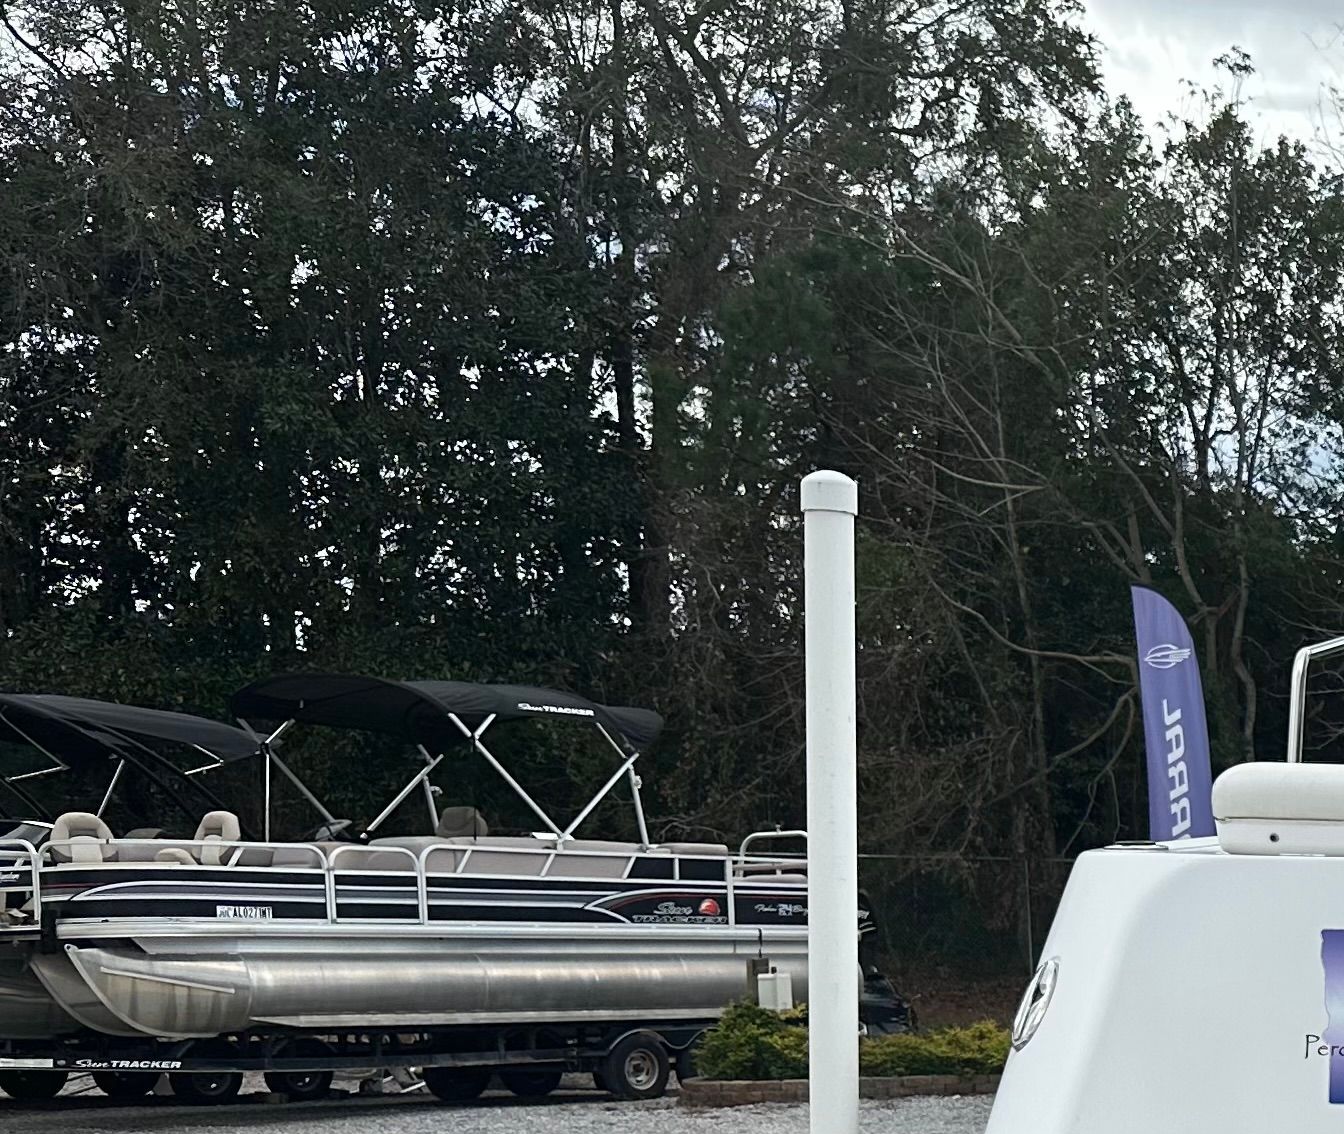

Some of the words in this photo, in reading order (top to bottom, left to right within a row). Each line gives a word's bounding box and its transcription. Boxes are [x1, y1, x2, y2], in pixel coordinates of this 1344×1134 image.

[542, 705, 595, 717] TRACKER
[632, 914, 729, 924] TRACKER
[110, 1060, 182, 1069] TRACKER
